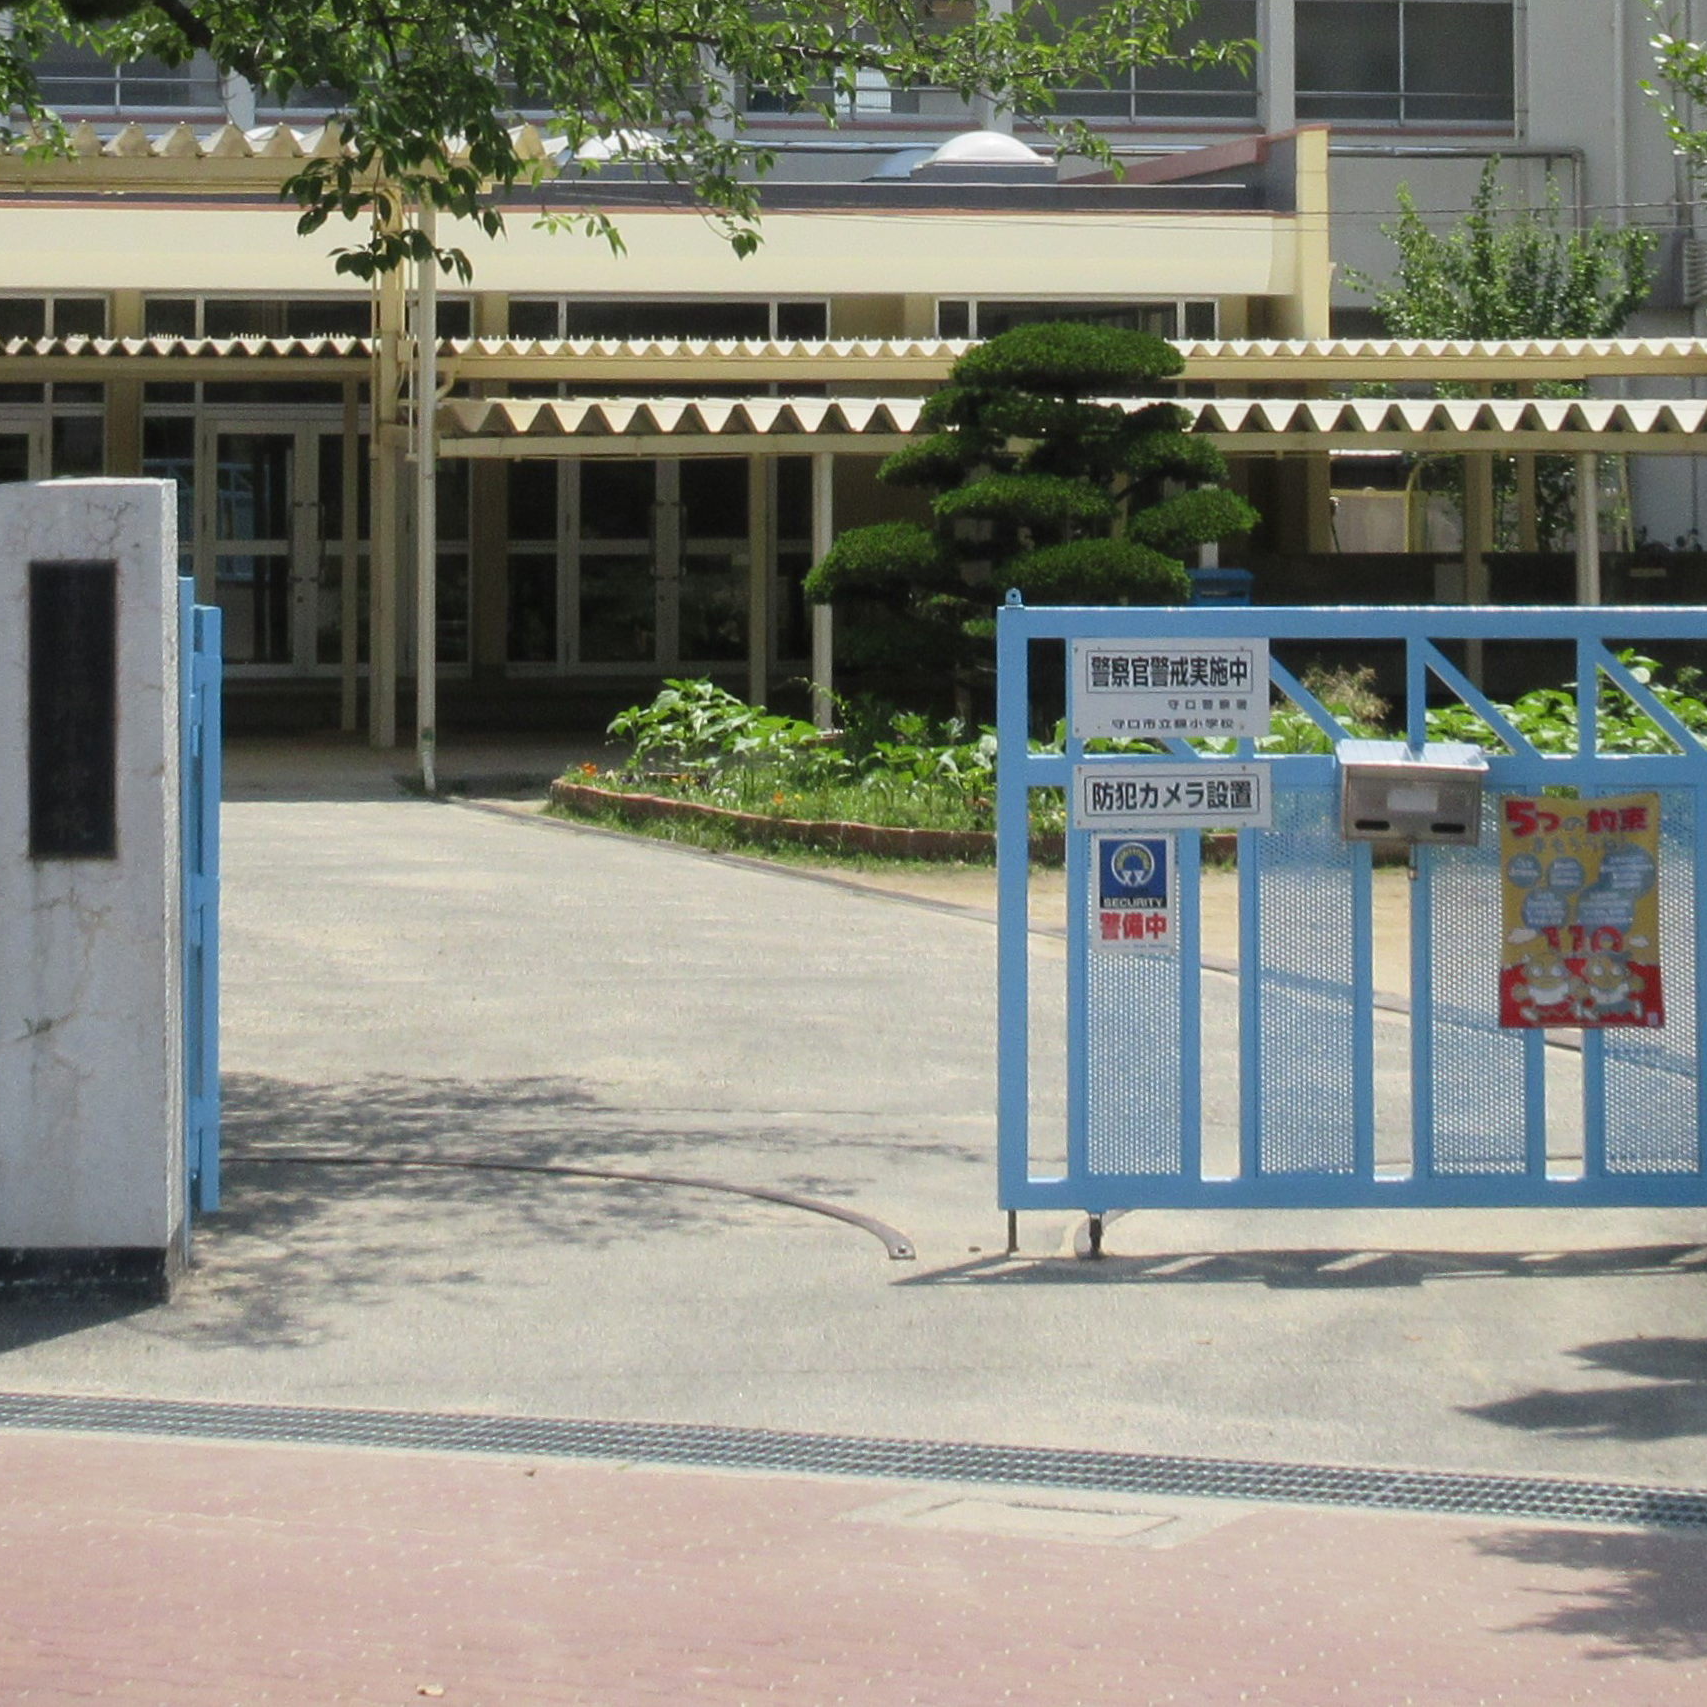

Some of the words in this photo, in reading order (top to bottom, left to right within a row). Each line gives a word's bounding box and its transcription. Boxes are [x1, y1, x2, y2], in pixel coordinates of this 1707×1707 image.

[1091, 656, 1248, 688] 警察官警戒実施中
[1092, 780, 1252, 811] 防犯カメラ設置
[1103, 897, 1164, 908] SECURITY
[1100, 912, 1168, 940] 警備中
